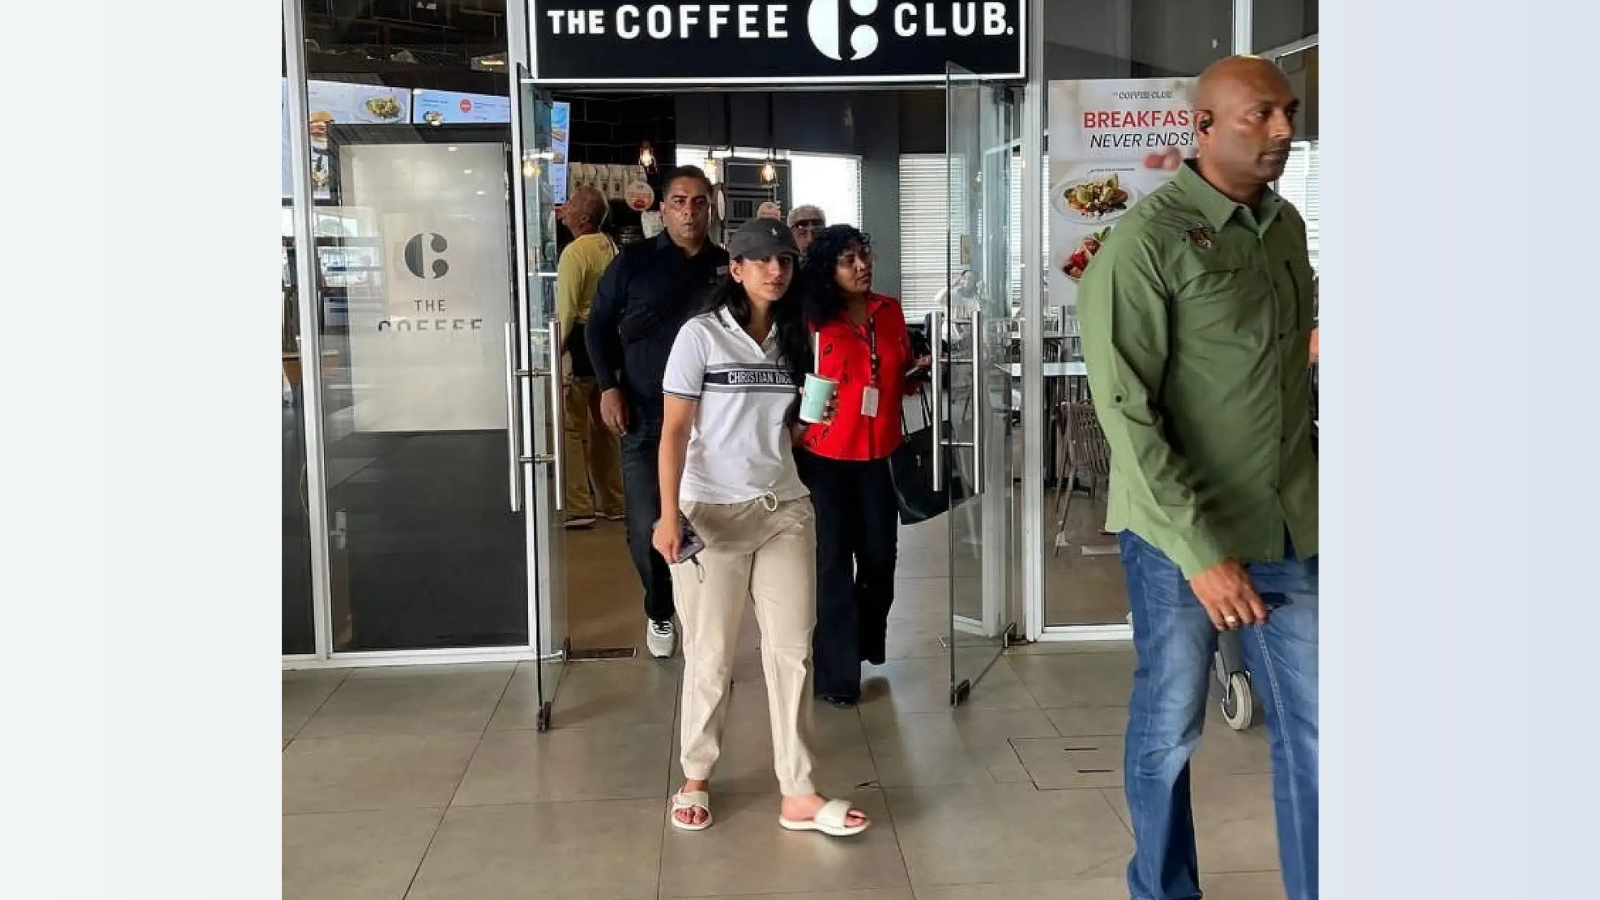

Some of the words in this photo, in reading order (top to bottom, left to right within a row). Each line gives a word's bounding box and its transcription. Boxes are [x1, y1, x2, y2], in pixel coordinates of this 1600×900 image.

[547, 9, 605, 35] THE
[615, 4, 789, 39] COFFEE
[894, 2, 1014, 37] CLUB.
[1083, 110, 1195, 128] BREAKFAS
[1090, 133, 1142, 148] NEVER
[1146, 132, 1195, 147] ENDS!
[414, 300, 446, 312] THE
[728, 371, 773, 384] CHRISTIAN
